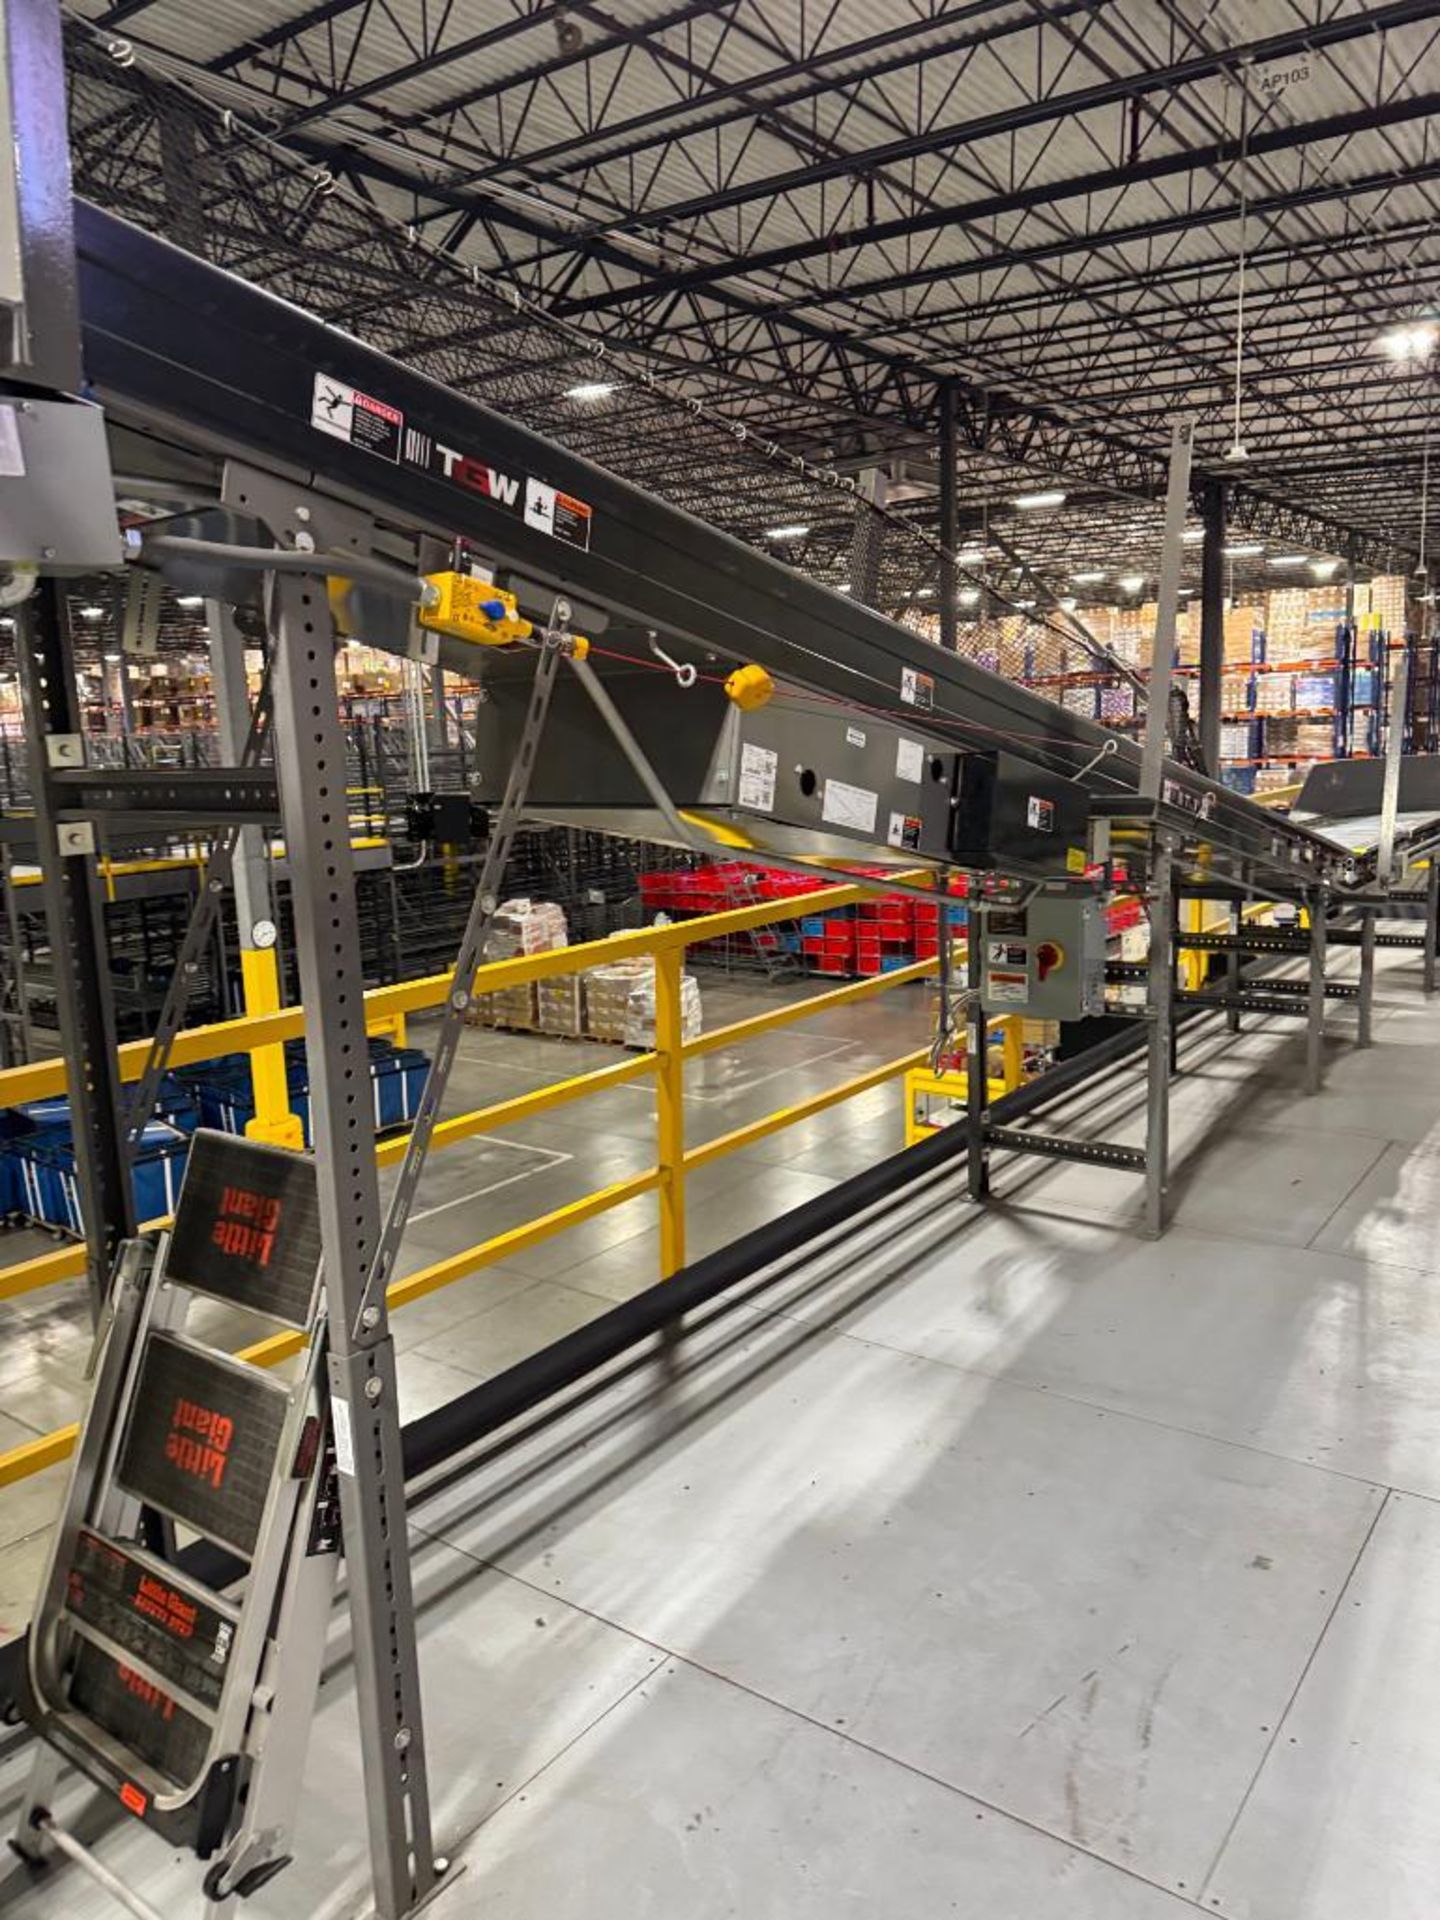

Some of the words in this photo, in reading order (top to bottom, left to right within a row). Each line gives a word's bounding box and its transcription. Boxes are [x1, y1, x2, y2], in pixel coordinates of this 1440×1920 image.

[436, 444, 519, 506] TGW
[212, 1219, 276, 1267] Little
[173, 1400, 234, 1451] Giant
[165, 1433, 228, 1488] Little
